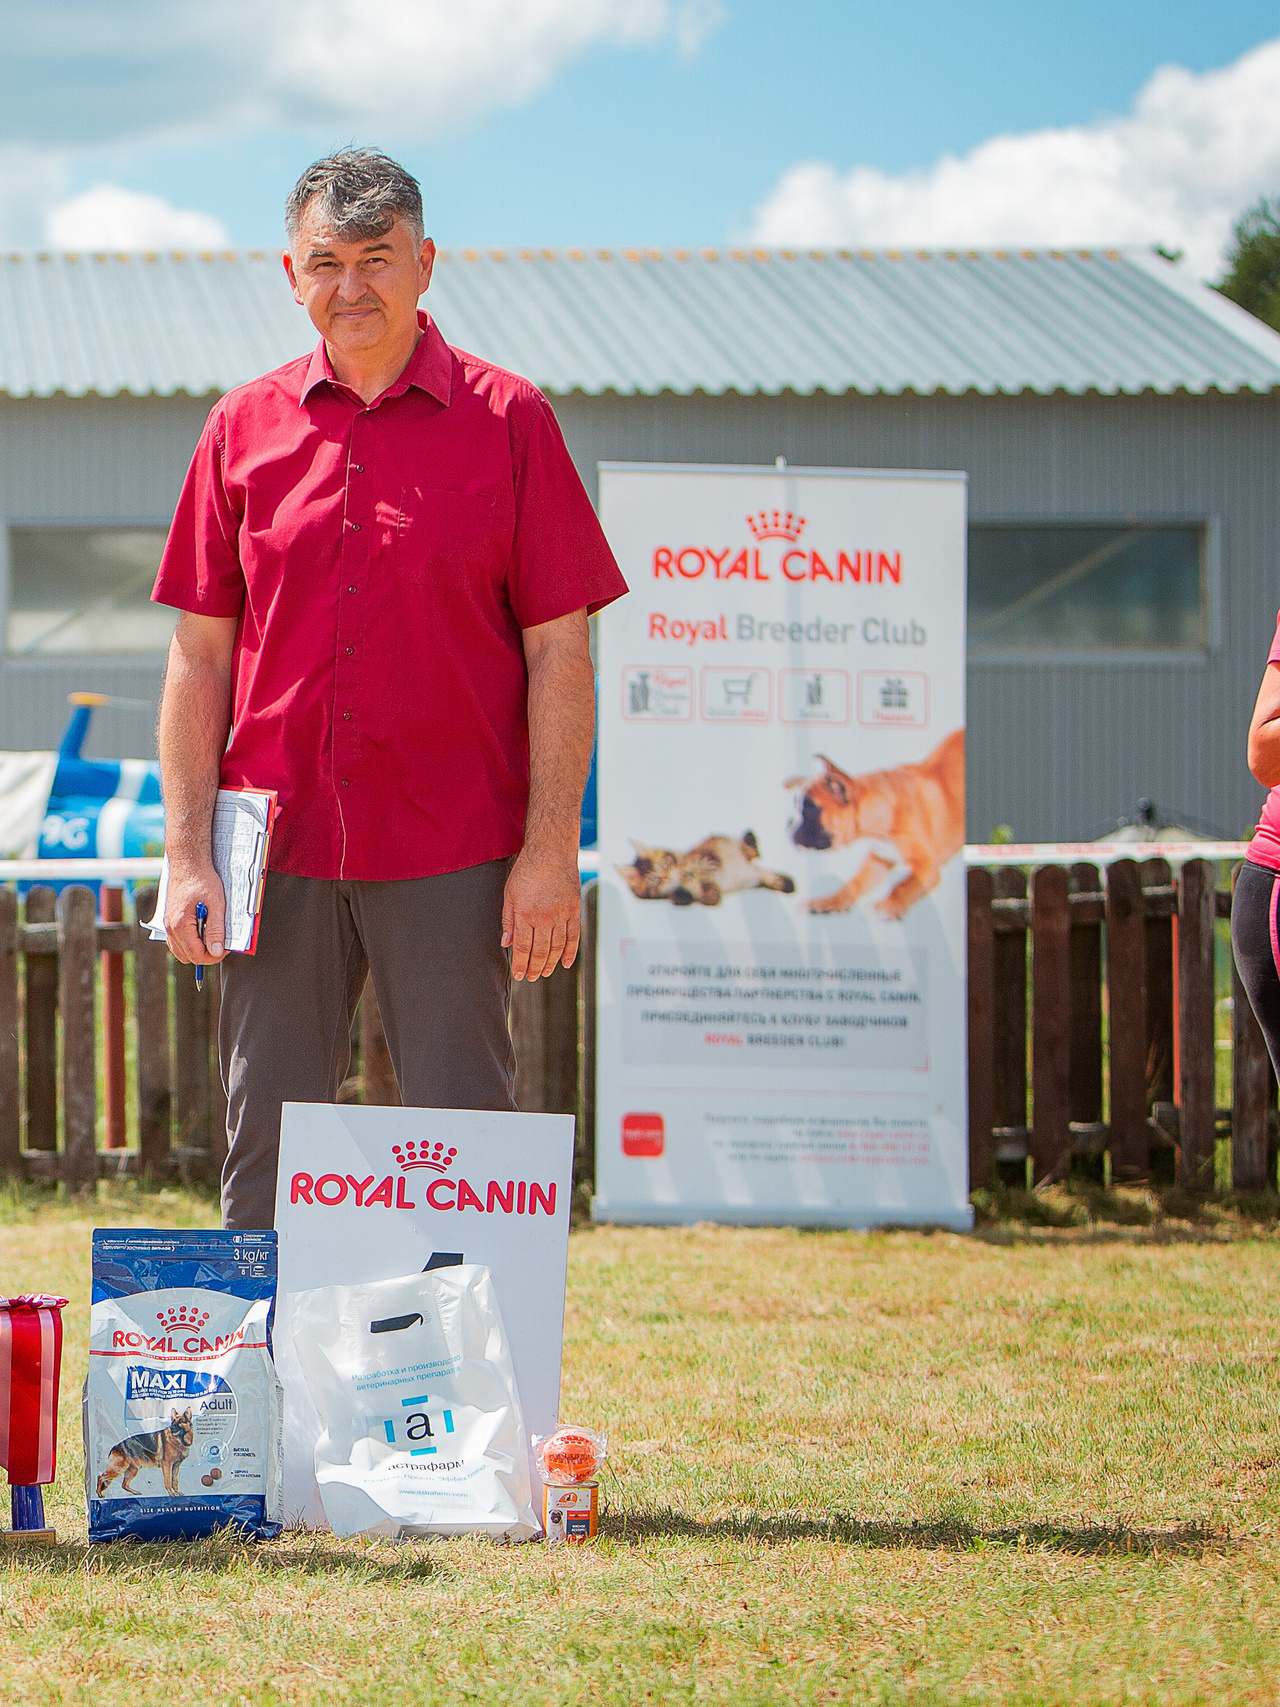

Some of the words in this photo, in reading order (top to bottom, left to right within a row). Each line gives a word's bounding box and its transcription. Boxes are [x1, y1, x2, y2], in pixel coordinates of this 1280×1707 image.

[652, 547, 770, 580] ROYAL
[781, 550, 902, 584] CANIN
[648, 613, 727, 645] Royal
[736, 614, 853, 643] Breeder
[862, 618, 928, 646] Club
[291, 1172, 416, 1210] ROYAL
[426, 1178, 557, 1216] CANIN
[233, 1248, 240, 1260] 3
[112, 1330, 178, 1353] ROYAL
[183, 1326, 245, 1353] CANIN
[131, 1370, 187, 1390] MAXI
[352, 1368, 400, 1381] Разработка
[356, 1375, 415, 1391] ветеринарных
[417, 1366, 461, 1380] препаратов
[199, 1399, 233, 1411] Adult
